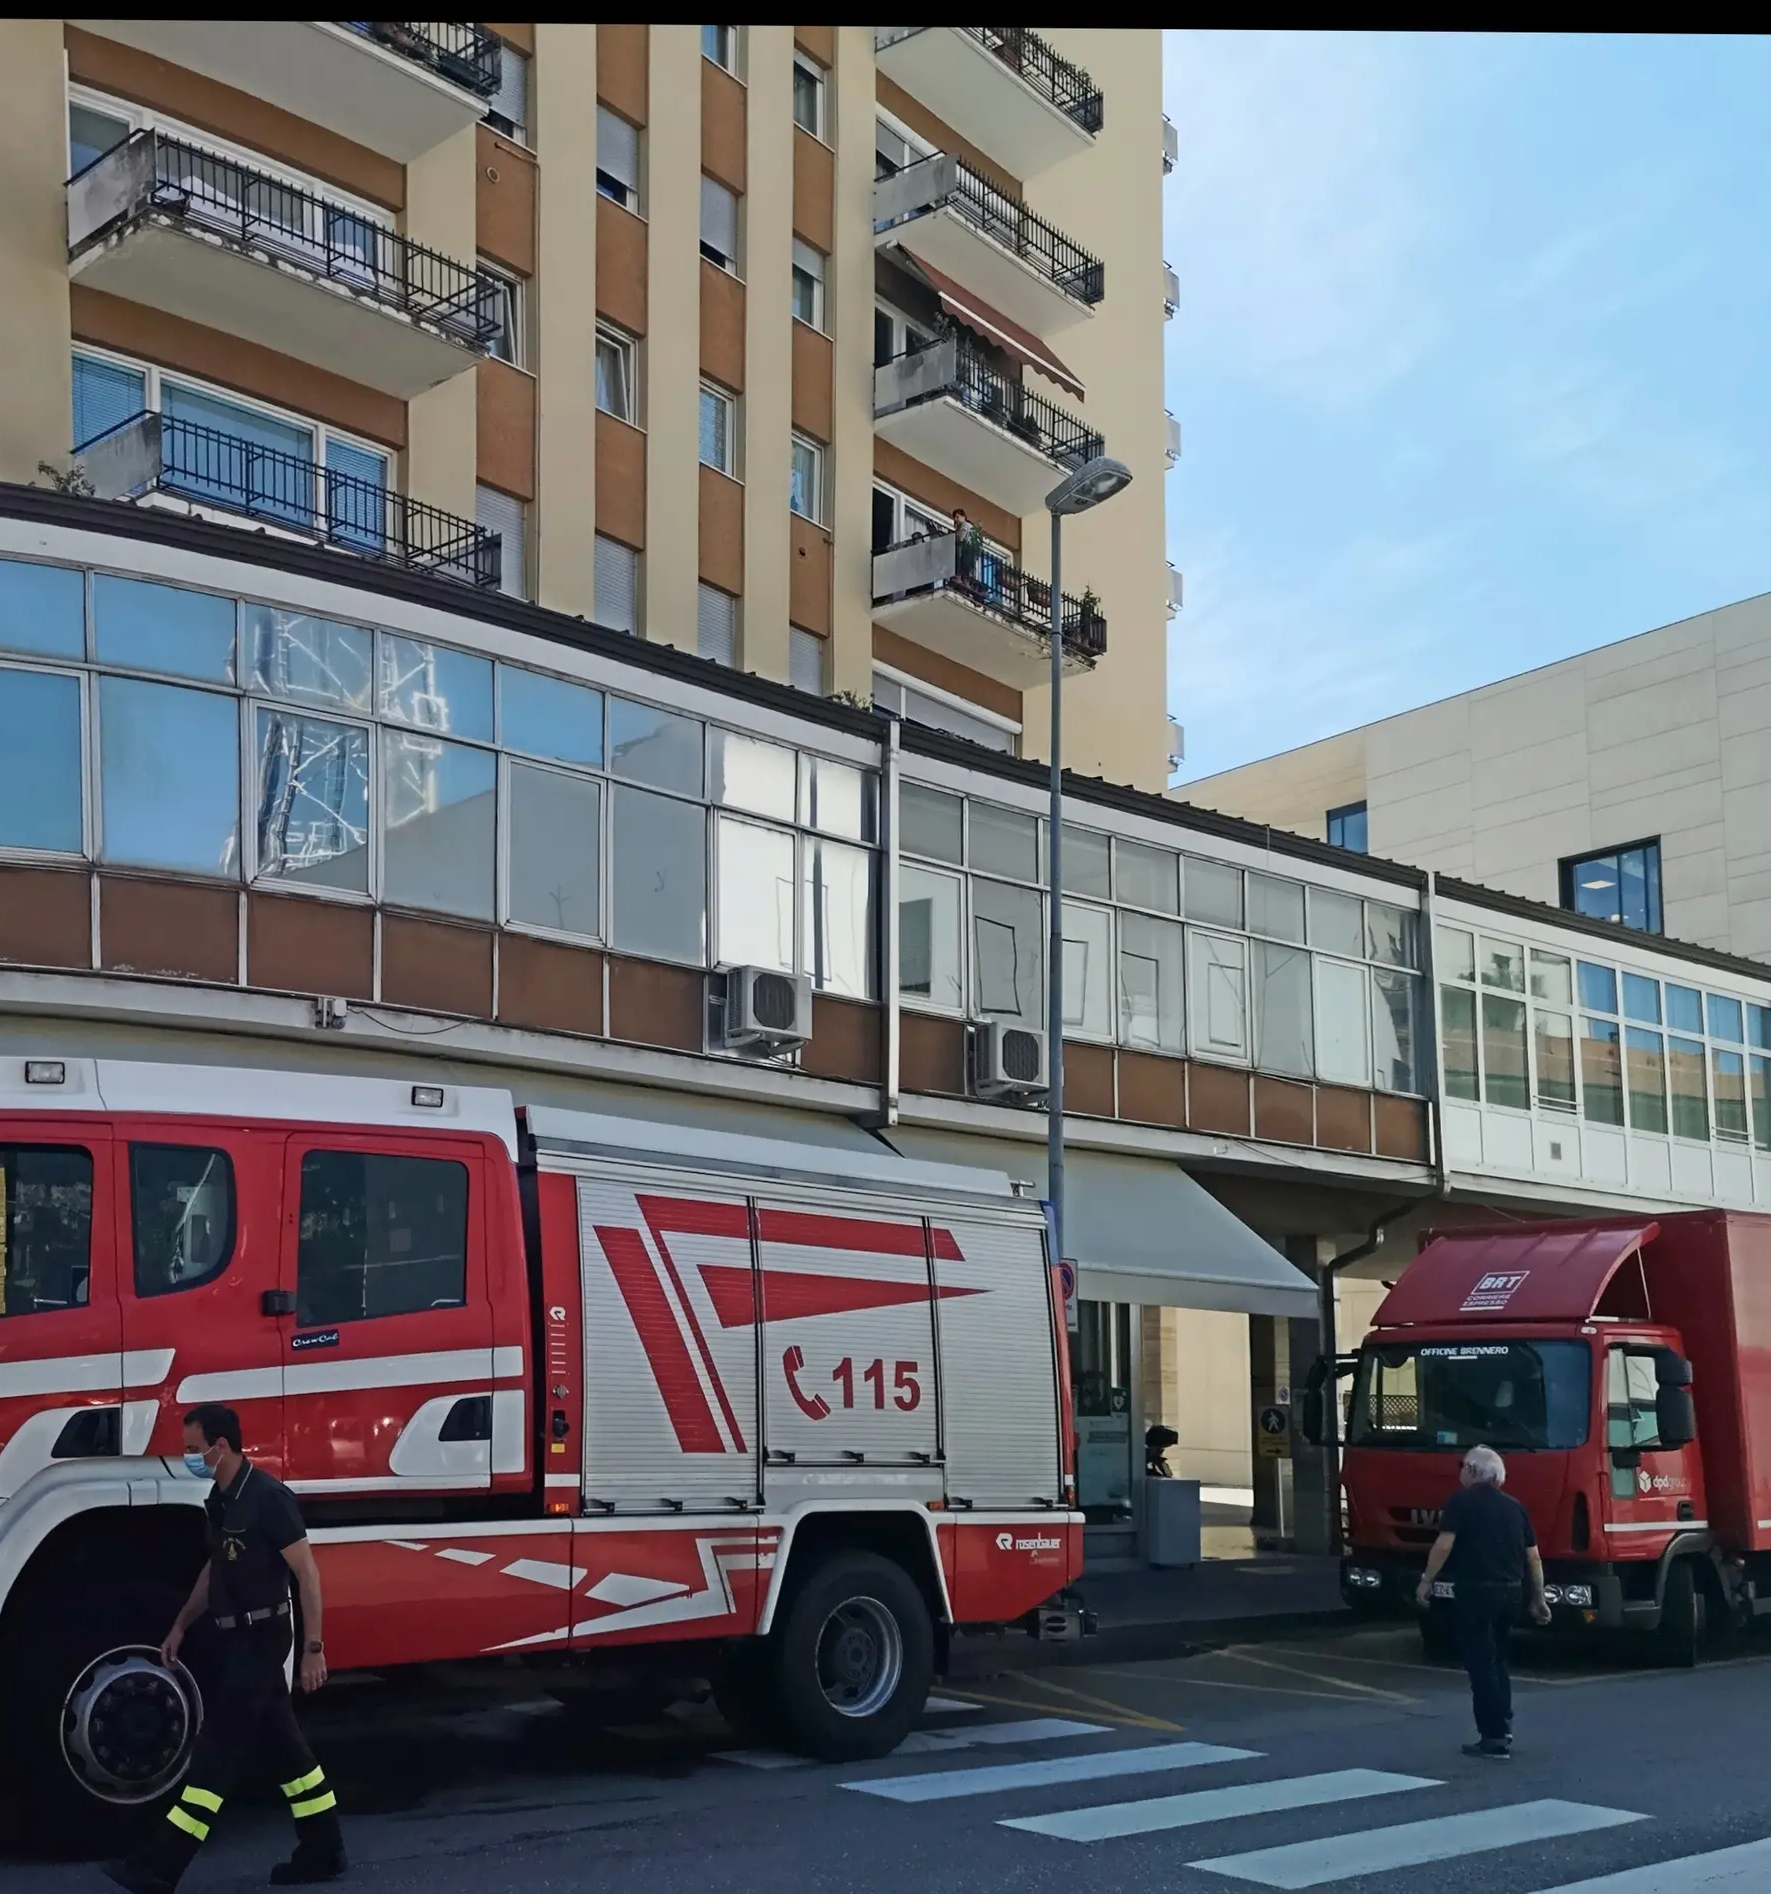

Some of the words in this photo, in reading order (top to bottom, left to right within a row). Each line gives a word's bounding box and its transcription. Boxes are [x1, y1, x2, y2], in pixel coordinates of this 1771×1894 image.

[1479, 1276, 1522, 1290] BRT
[1420, 1347, 1458, 1356] OFFICINE
[1460, 1346, 1509, 1355] BRENNERO
[832, 1357, 921, 1411] 115
